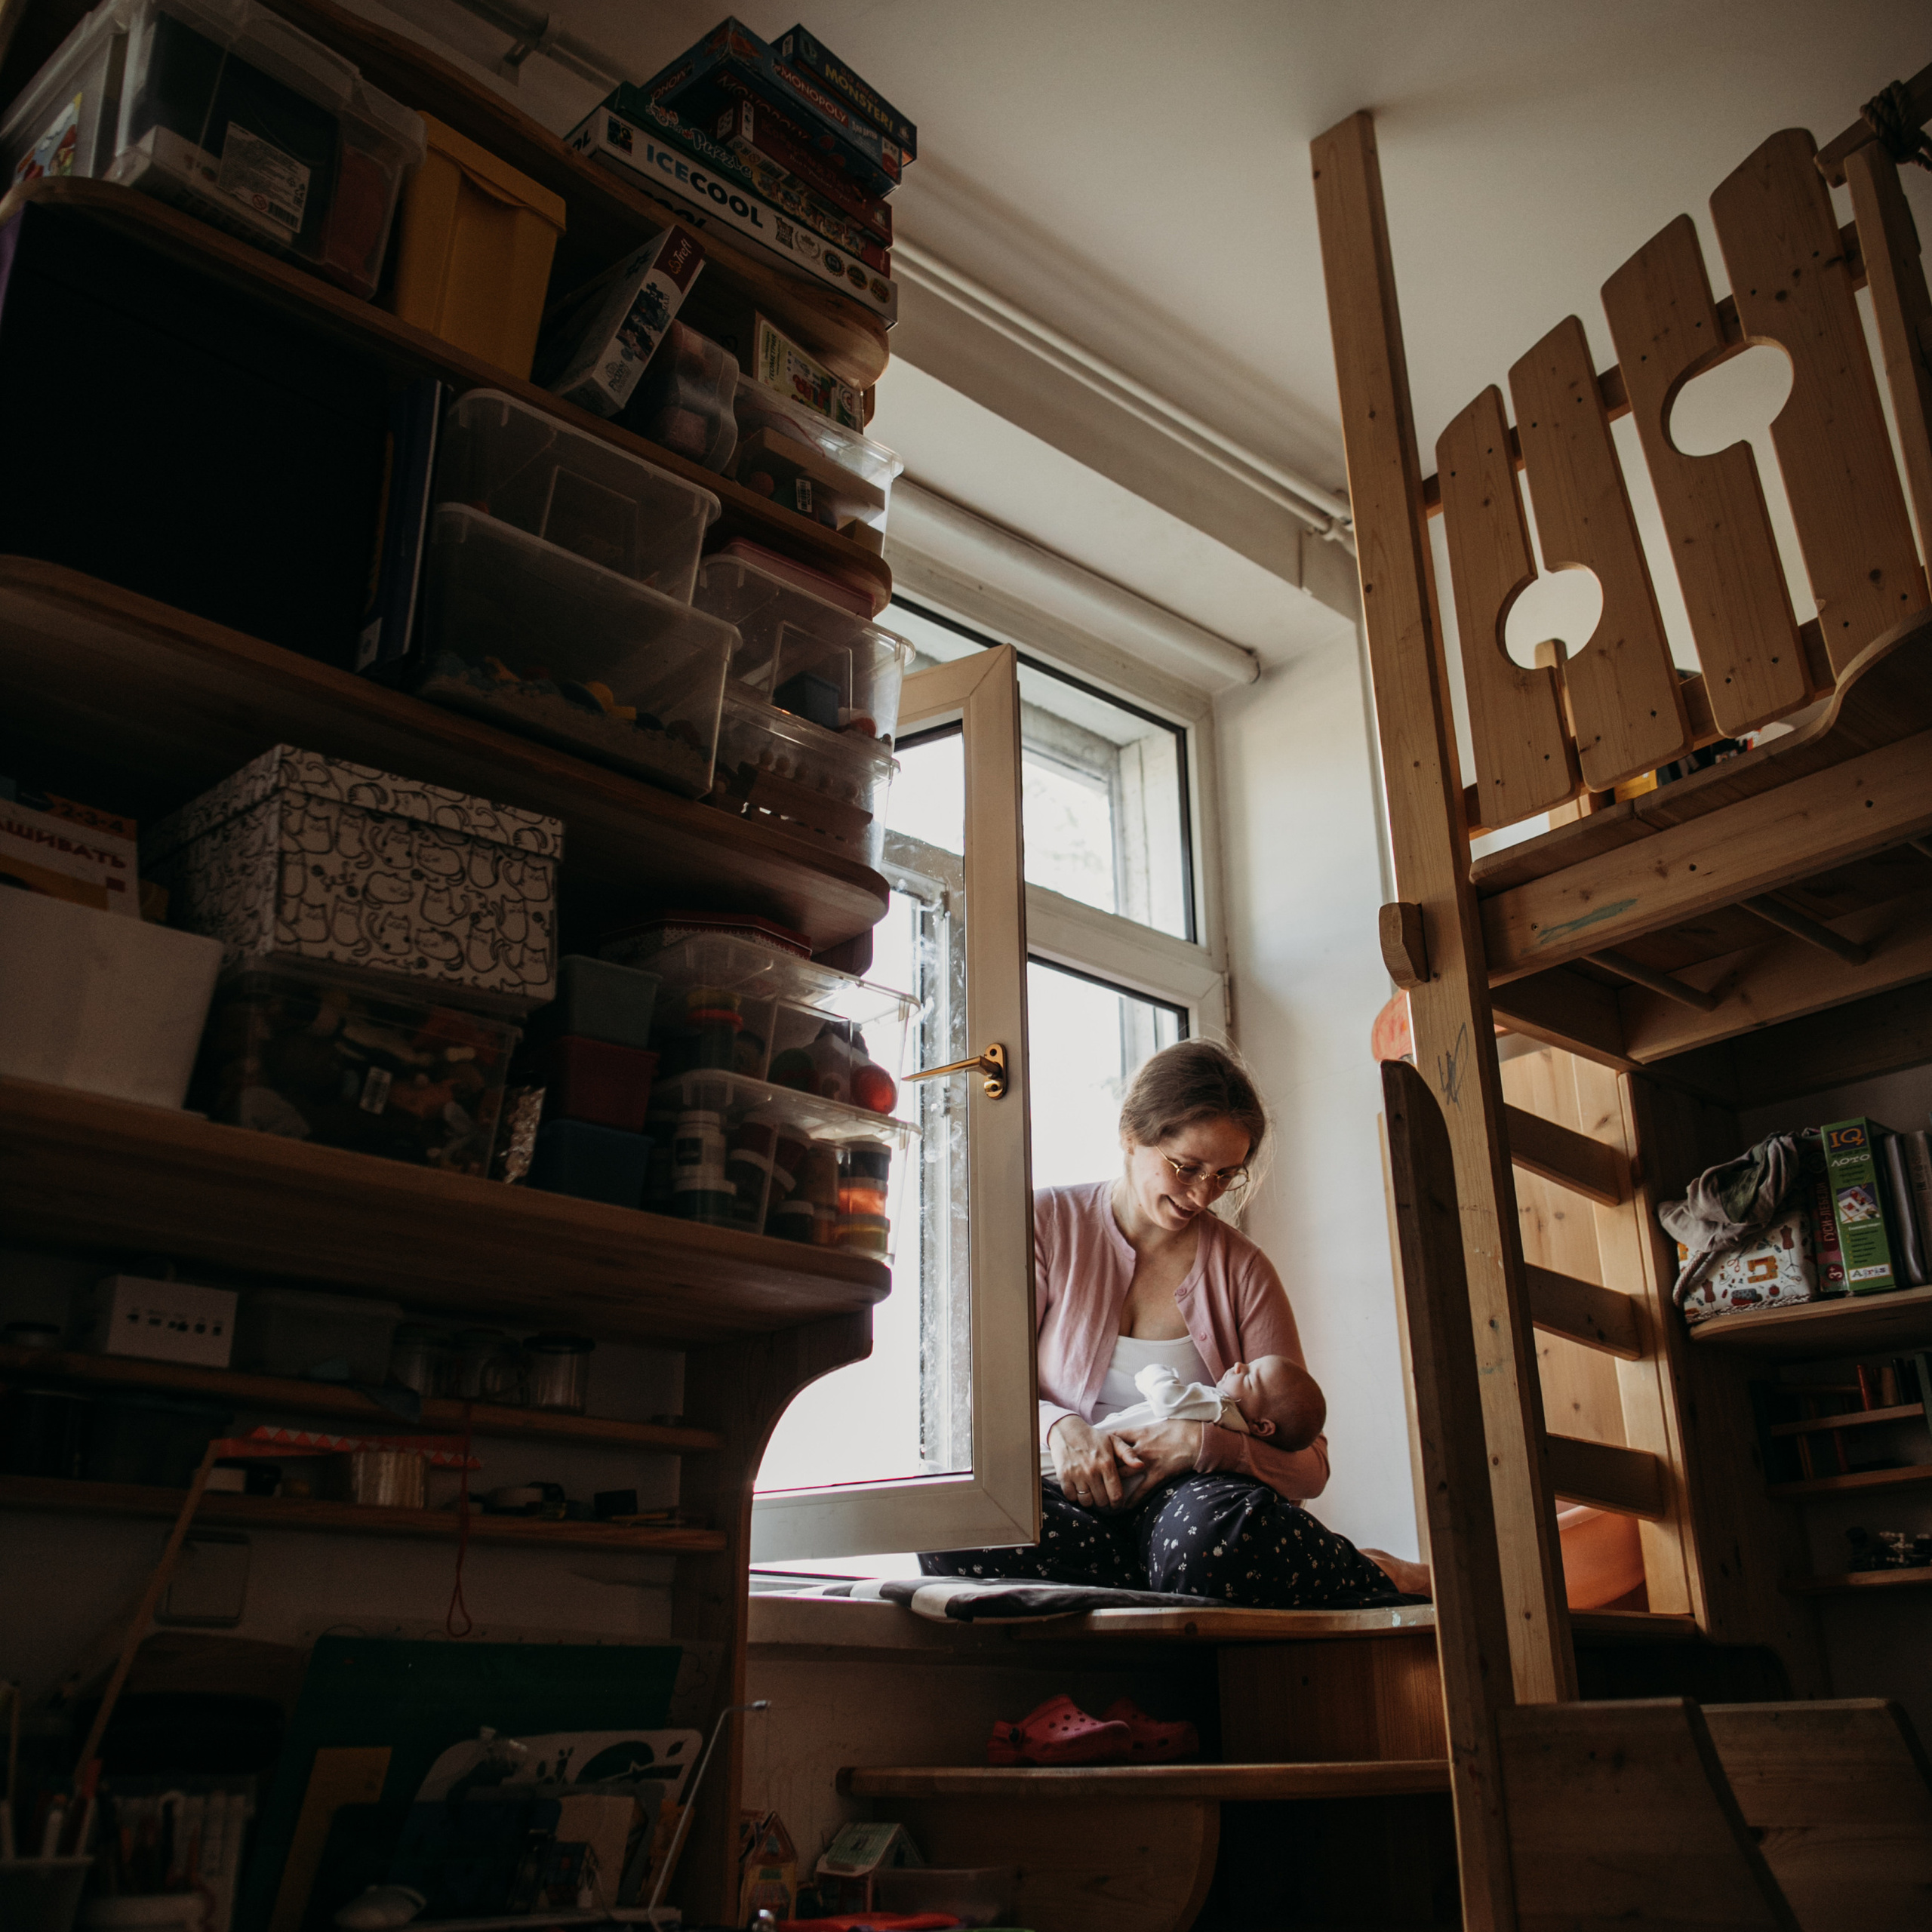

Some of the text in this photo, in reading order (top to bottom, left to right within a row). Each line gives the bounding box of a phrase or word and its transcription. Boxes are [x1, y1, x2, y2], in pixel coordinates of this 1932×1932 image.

[780, 65, 846, 123] MONOPOLY
[825, 63, 894, 133] MONSTER!
[840, 66, 879, 104] GO AWAY
[691, 127, 752, 179] Puzzle
[647, 143, 763, 228] ICECOOL
[673, 238, 693, 264] Trefl
[1829, 1128, 1866, 1149] IQ
[1828, 1266, 1843, 1279] 3+
